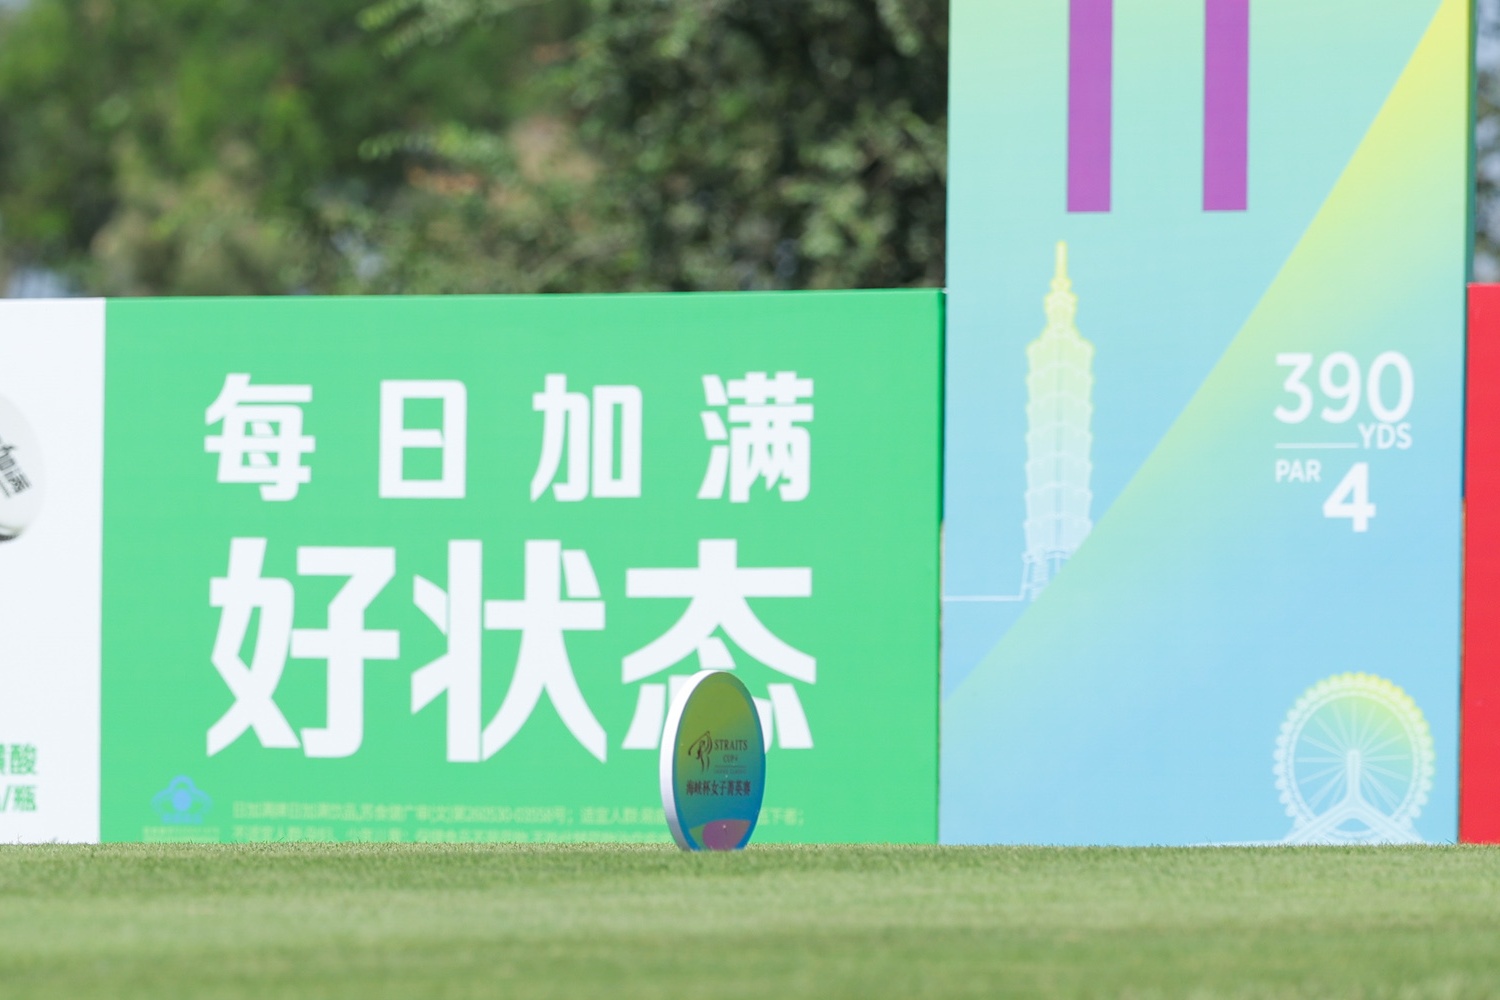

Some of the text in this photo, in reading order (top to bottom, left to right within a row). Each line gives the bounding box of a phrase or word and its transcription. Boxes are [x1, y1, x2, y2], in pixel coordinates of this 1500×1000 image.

[1274, 351, 1414, 424] 390
[204, 371, 815, 503] 每日加满
[1358, 423, 1414, 450] YDS
[1274, 461, 1377, 532] PAR 4
[206, 537, 818, 763] 好状态
[714, 739, 748, 751] STRAITS
